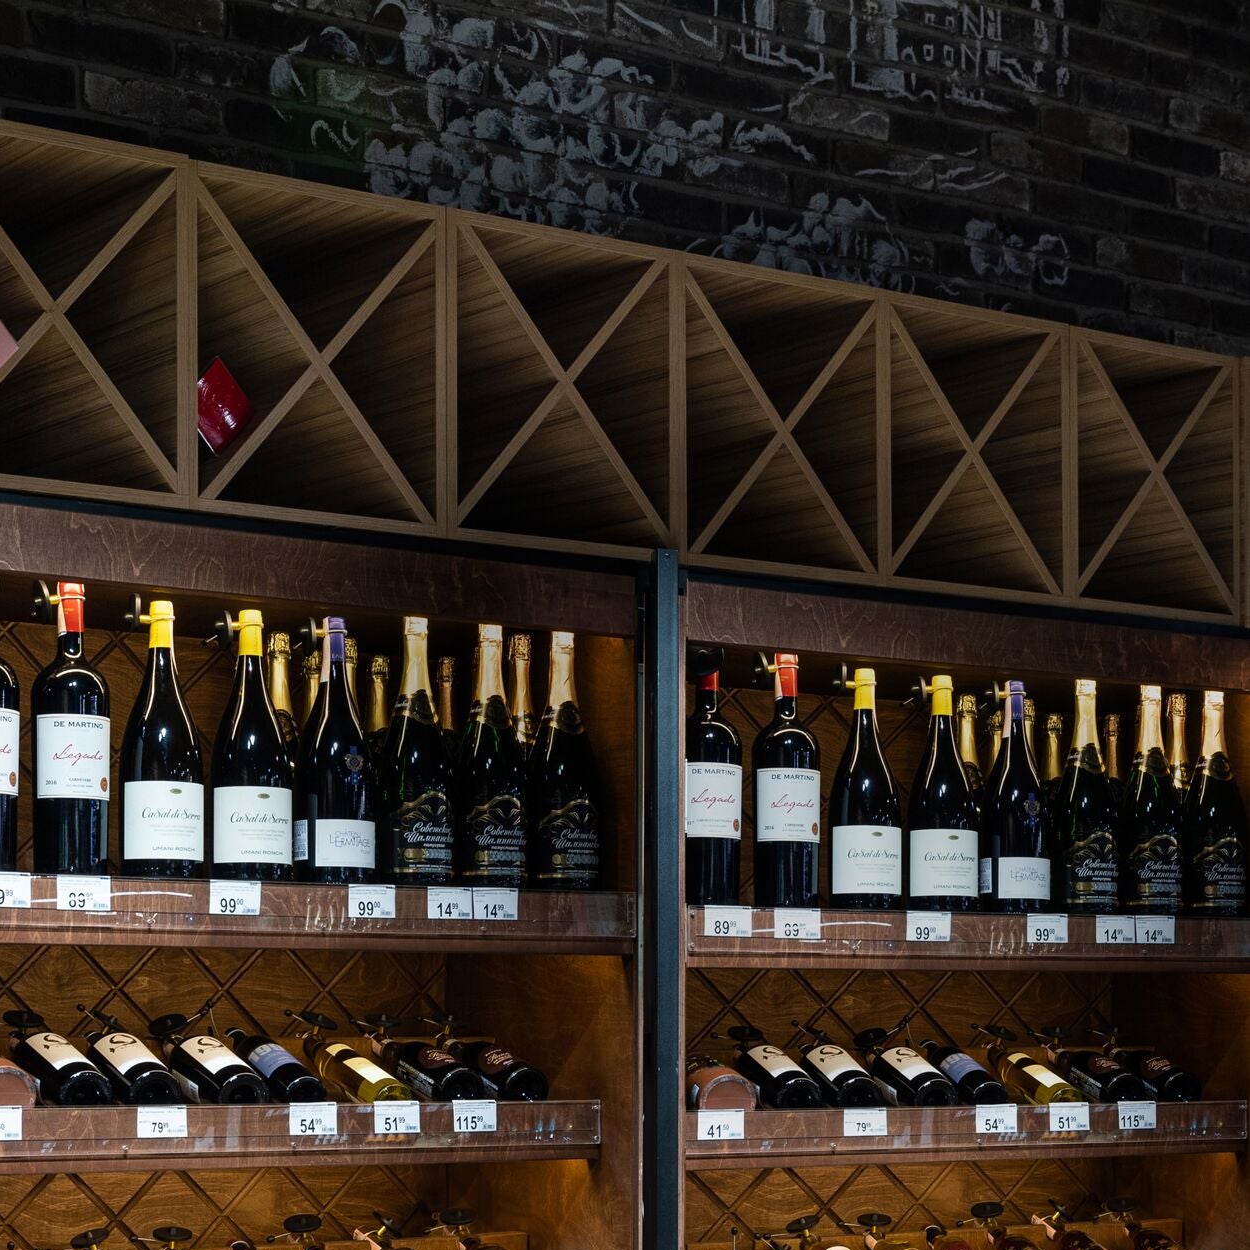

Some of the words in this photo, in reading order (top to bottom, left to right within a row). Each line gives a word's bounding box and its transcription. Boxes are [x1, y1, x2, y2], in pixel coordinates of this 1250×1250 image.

[67, 721, 104, 730] MARTINO
[704, 768, 736, 776] MARTINO
[783, 774, 815, 782] MARTINO
